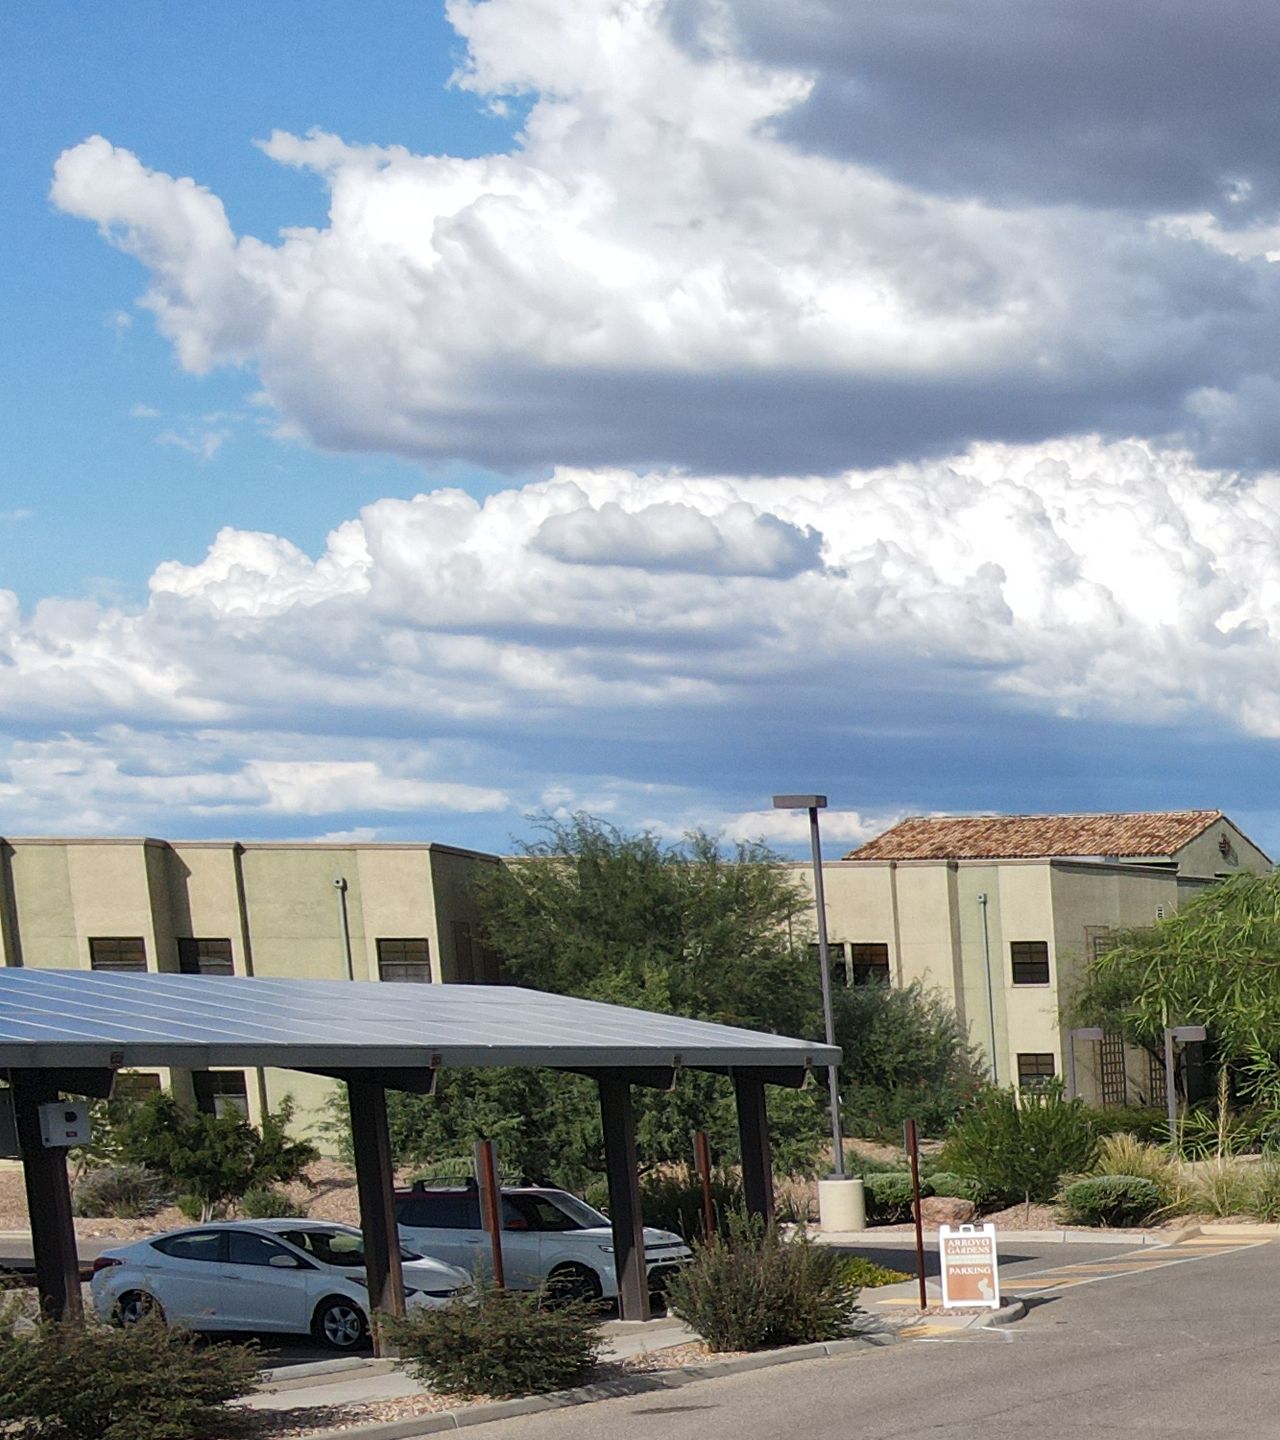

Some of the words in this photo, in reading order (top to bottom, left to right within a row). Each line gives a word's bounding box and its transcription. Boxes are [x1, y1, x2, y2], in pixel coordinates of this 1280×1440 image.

[947, 1238, 990, 1247] ARROYO
[947, 1246, 991, 1255] GARDENS
[948, 1266, 991, 1276] PARKING
